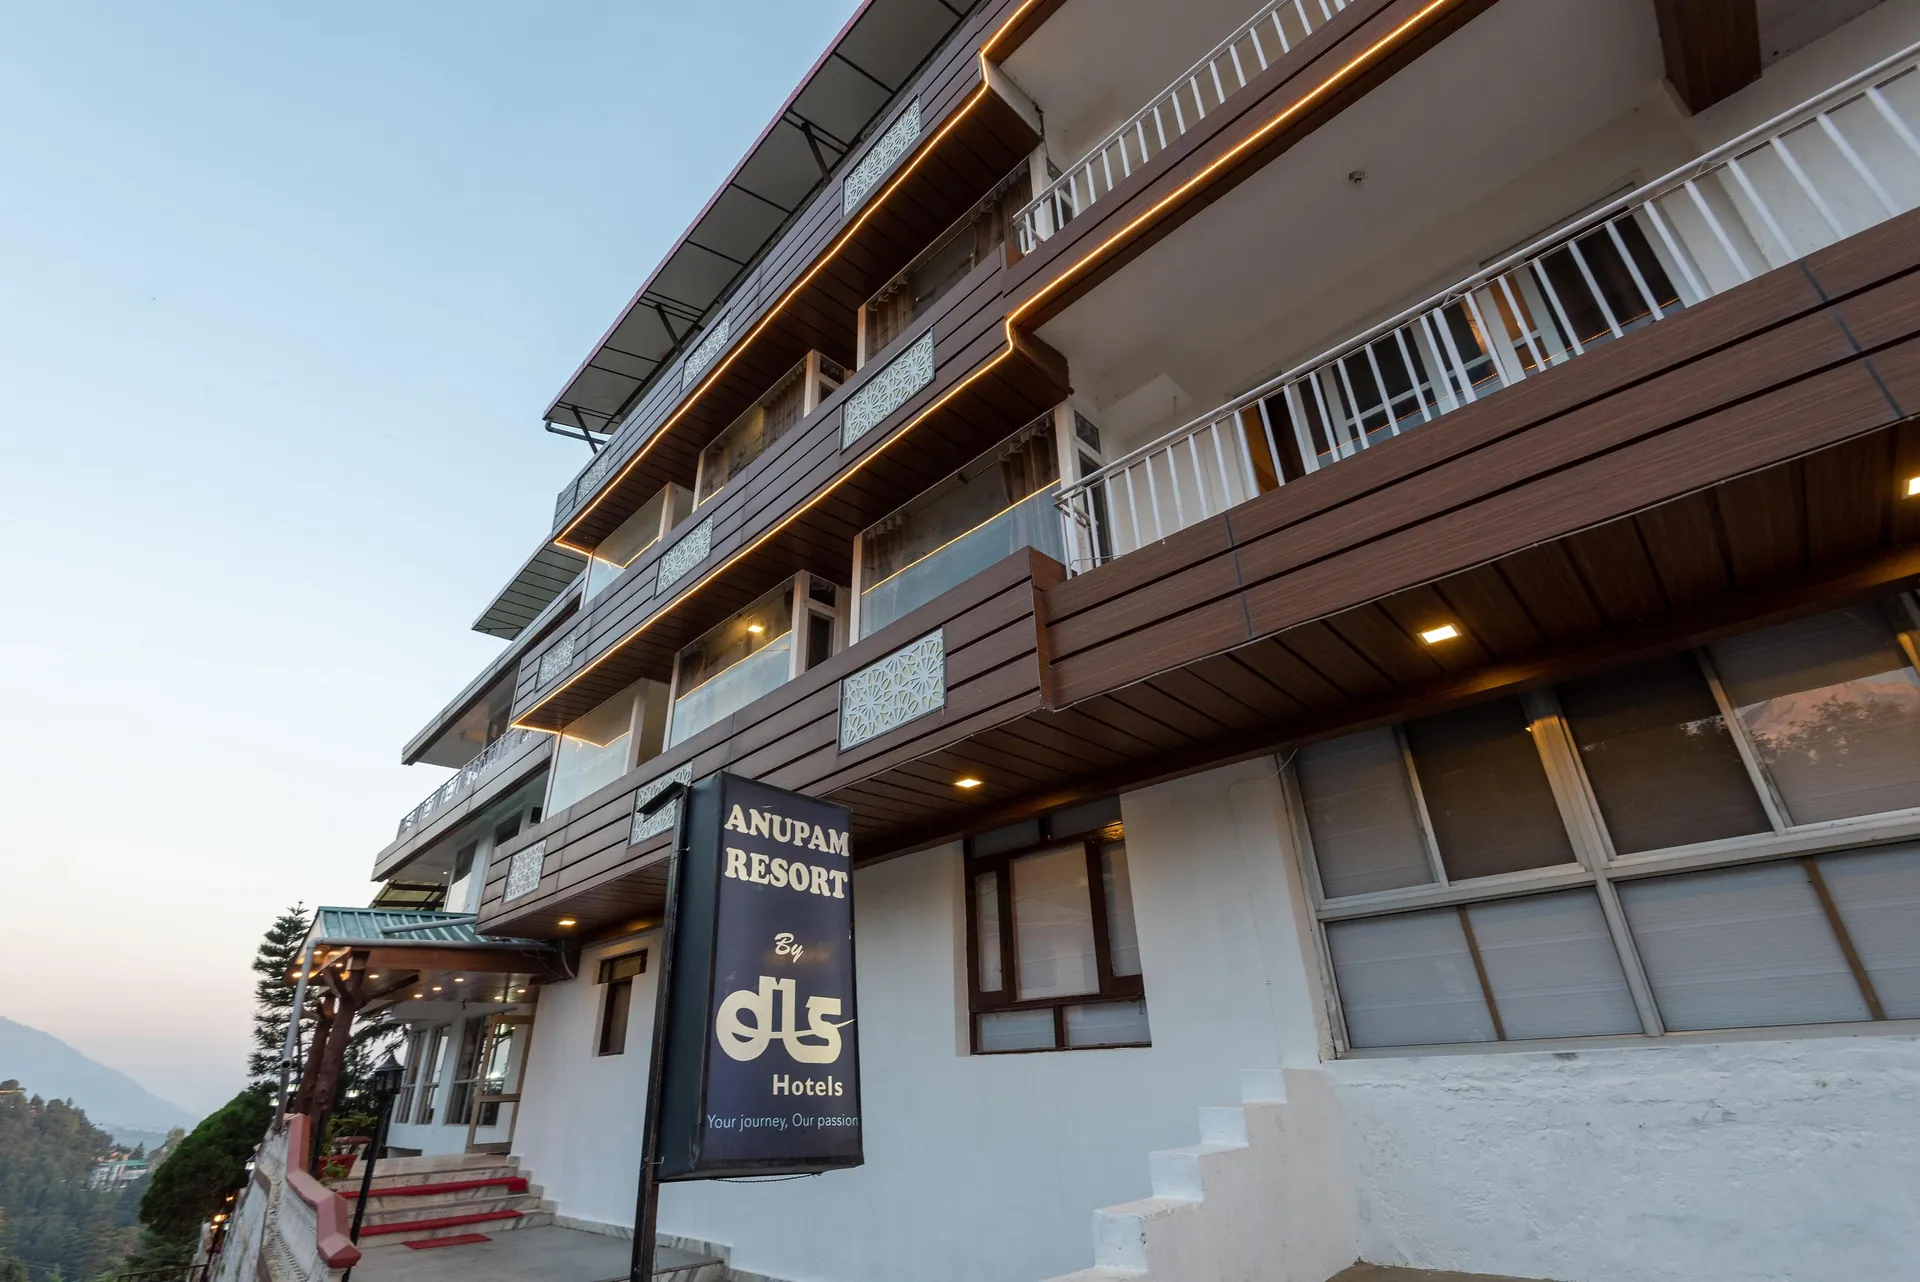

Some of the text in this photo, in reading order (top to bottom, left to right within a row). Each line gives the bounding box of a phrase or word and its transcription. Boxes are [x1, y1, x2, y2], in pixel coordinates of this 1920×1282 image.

[724, 804, 850, 857] ANUPAM
[724, 847, 848, 899] RESORT
[774, 932, 804, 963] By
[772, 1074, 844, 1097] Hotels
[707, 1112, 859, 1132] Your journey, Our passion
